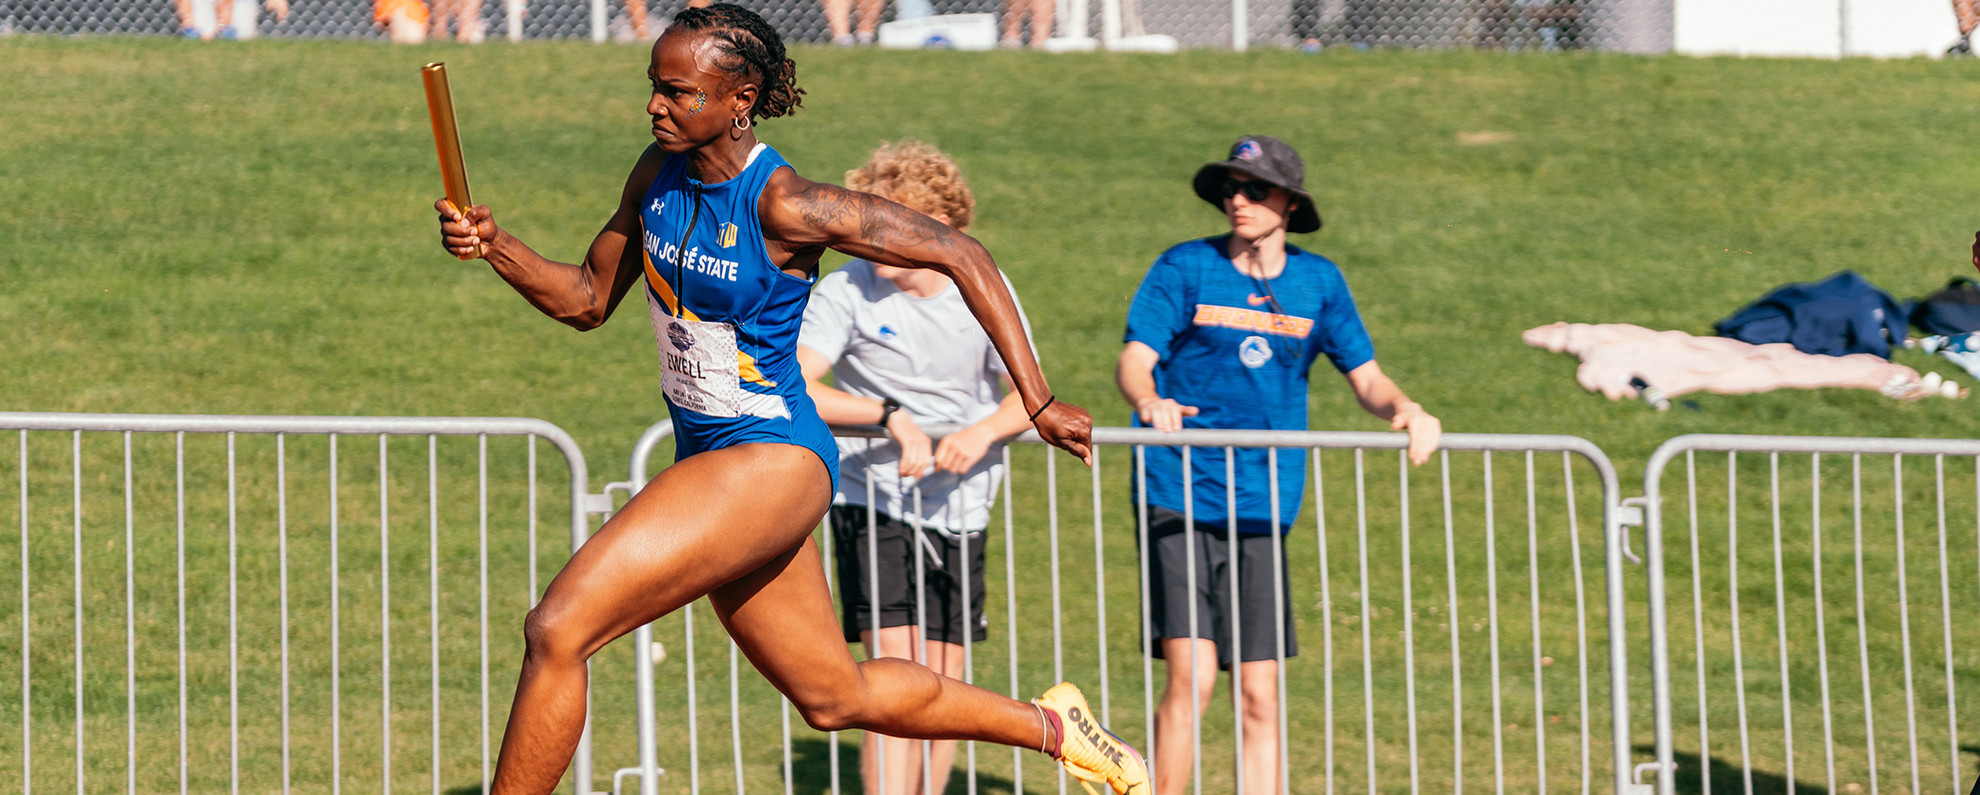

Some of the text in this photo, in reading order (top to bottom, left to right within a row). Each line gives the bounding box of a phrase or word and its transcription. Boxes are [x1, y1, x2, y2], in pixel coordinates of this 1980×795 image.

[645, 229, 660, 256] SAN
[697, 254, 739, 282] STATE
[1193, 304, 1314, 339] BRONCOS
[666, 352, 706, 379] EWELL
[1068, 707, 1124, 769] NITRO
